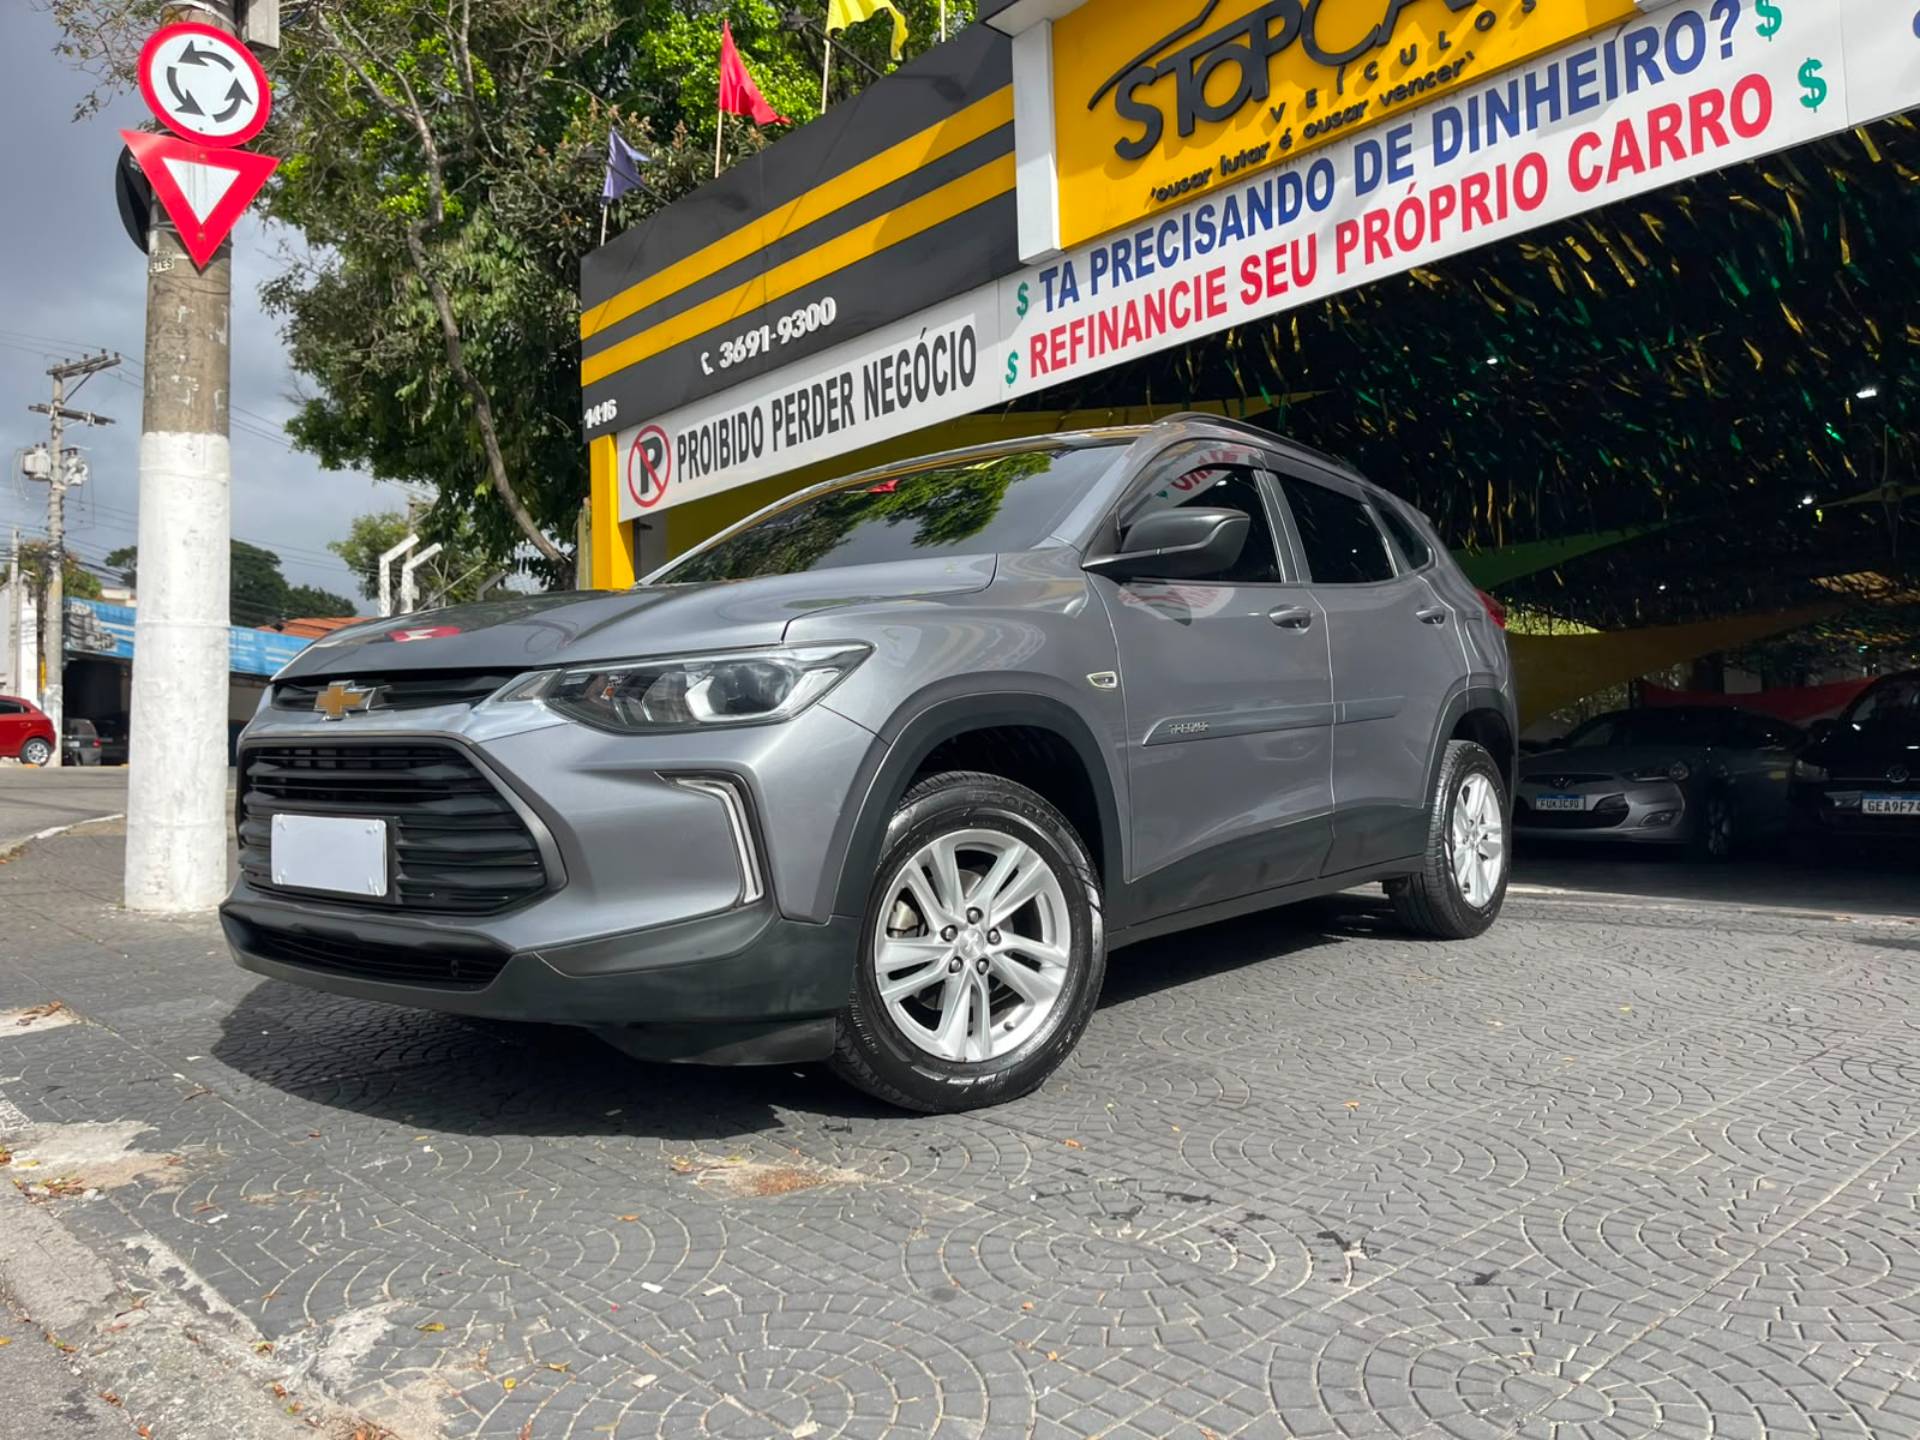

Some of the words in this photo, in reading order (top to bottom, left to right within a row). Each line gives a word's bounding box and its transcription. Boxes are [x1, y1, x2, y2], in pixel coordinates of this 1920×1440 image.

[1039, 260, 1080, 312] TA
[1090, 158, 1335, 296] PRECISANDO
[1354, 122, 1414, 197] DE
[1433, 0, 1741, 167] DINHEIRO?
[1220, 142, 1270, 176] lutar
[1279, 128, 1292, 149] é
[1303, 100, 1369, 139] ousar
[1030, 266, 1228, 378] REFINANCIE
[1240, 234, 1317, 306] SEU
[1336, 152, 1548, 274] PRÓPRIO
[1568, 73, 1773, 193] CARRO
[719, 296, 837, 369] 3691-9300
[584, 398, 618, 430] 1416
[677, 405, 764, 483] PROIBIDO
[771, 371, 855, 453] PERDER
[863, 327, 977, 422] NEGÓCIO
